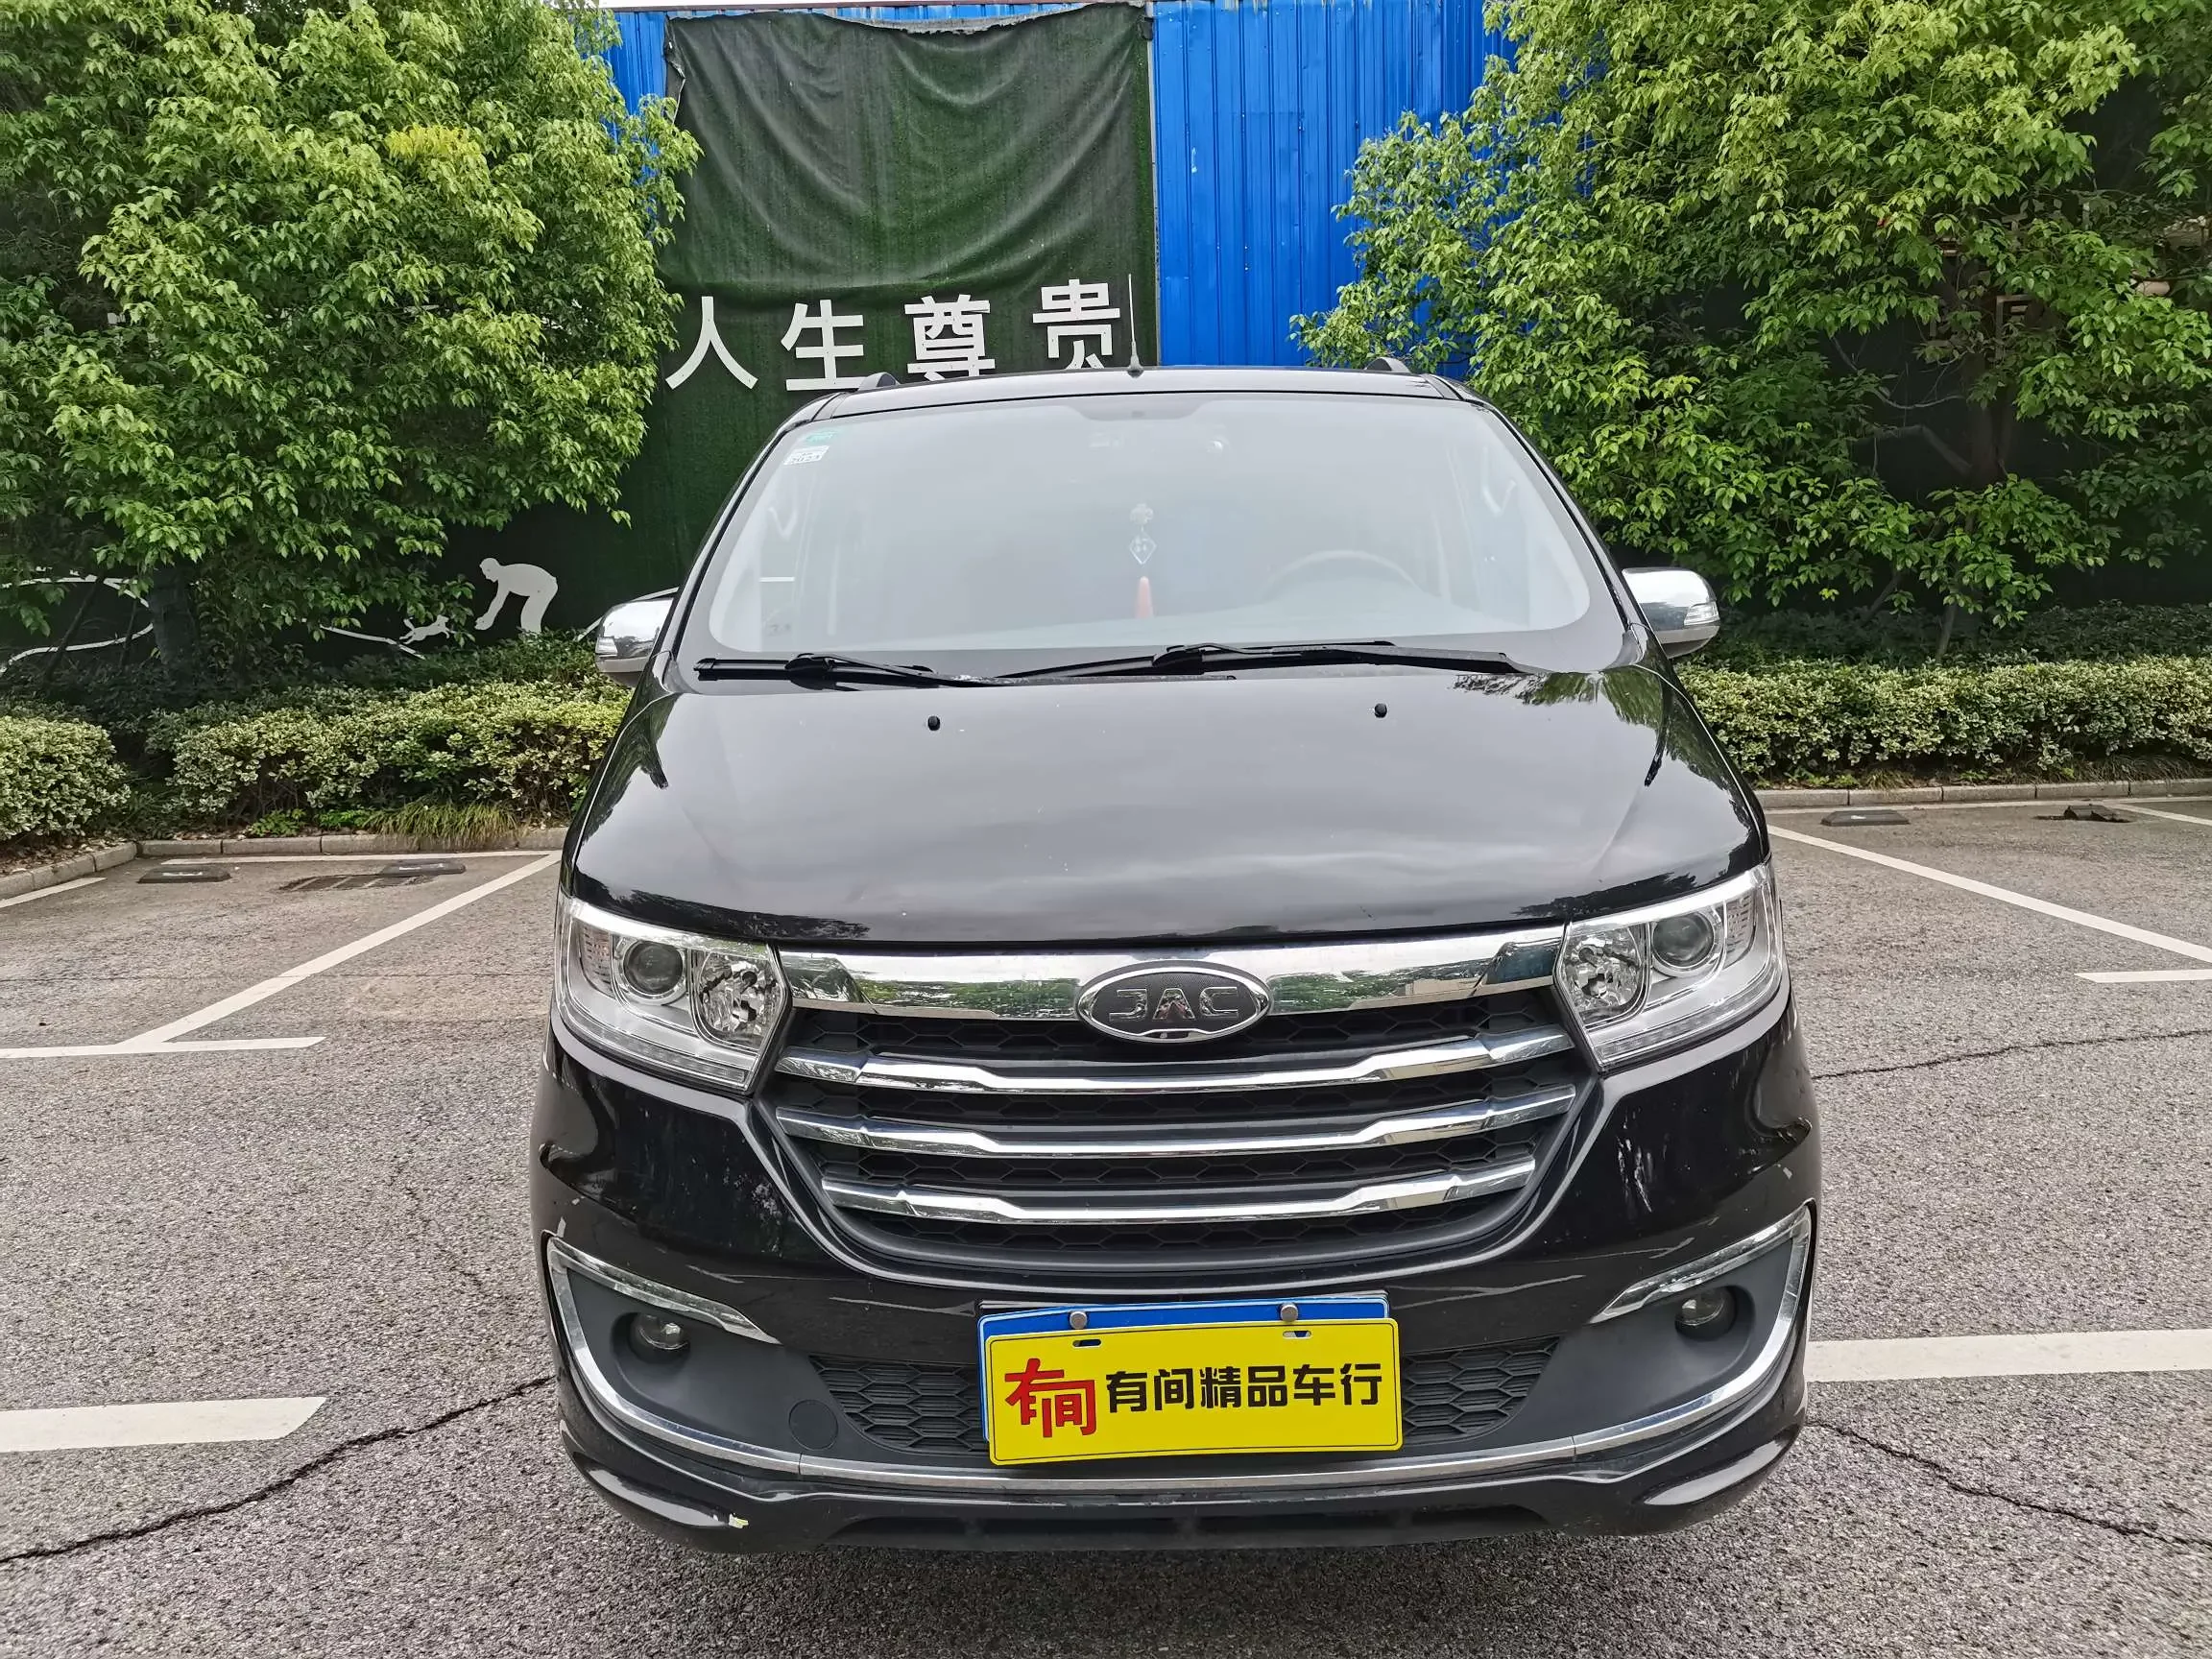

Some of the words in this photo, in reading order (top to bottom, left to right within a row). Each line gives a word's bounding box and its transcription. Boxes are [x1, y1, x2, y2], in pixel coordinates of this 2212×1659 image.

[1109, 986, 1239, 1022] JAC
[1106, 1362, 1382, 1413] 有间精品车行
